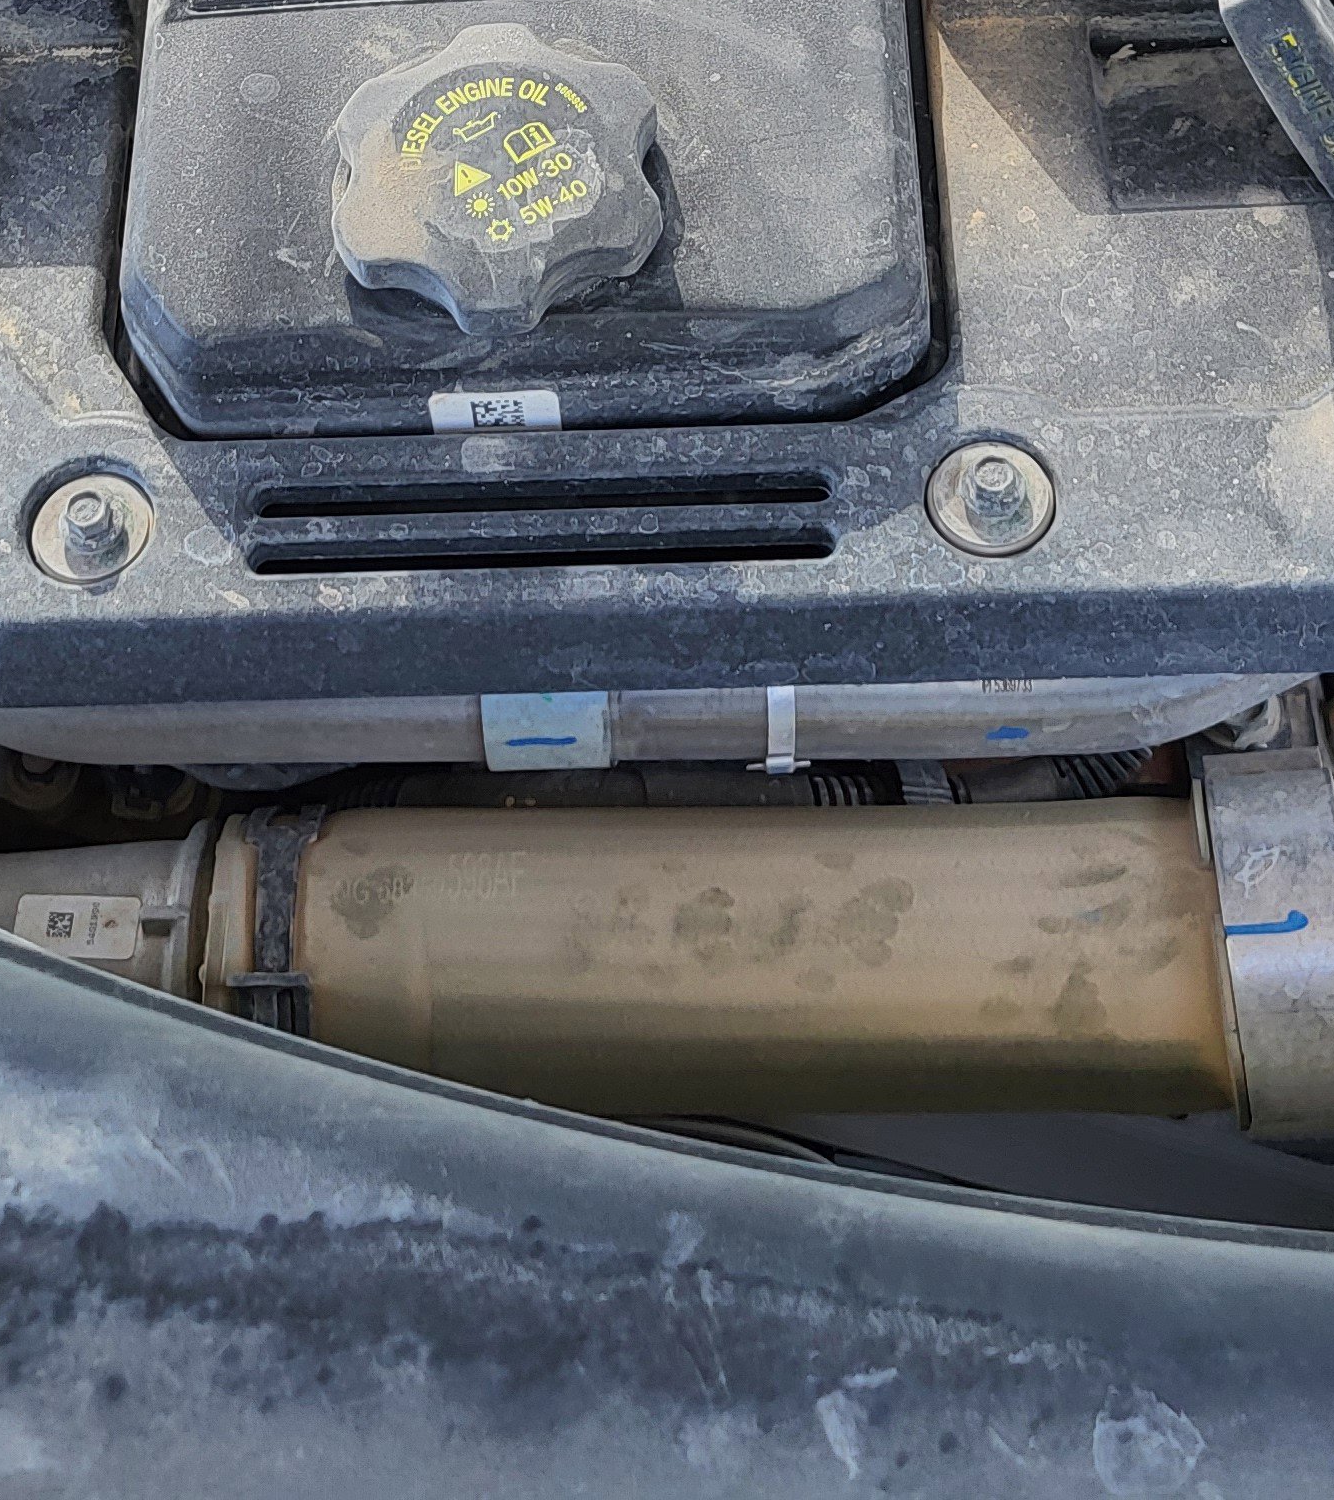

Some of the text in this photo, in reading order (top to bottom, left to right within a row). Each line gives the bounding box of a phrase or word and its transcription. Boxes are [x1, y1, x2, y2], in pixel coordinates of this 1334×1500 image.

[435, 77, 515, 115] ENGINE
[519, 80, 550, 106] OIL
[496, 152, 573, 200] 10W-30
[519, 179, 588, 225] 5W-40
